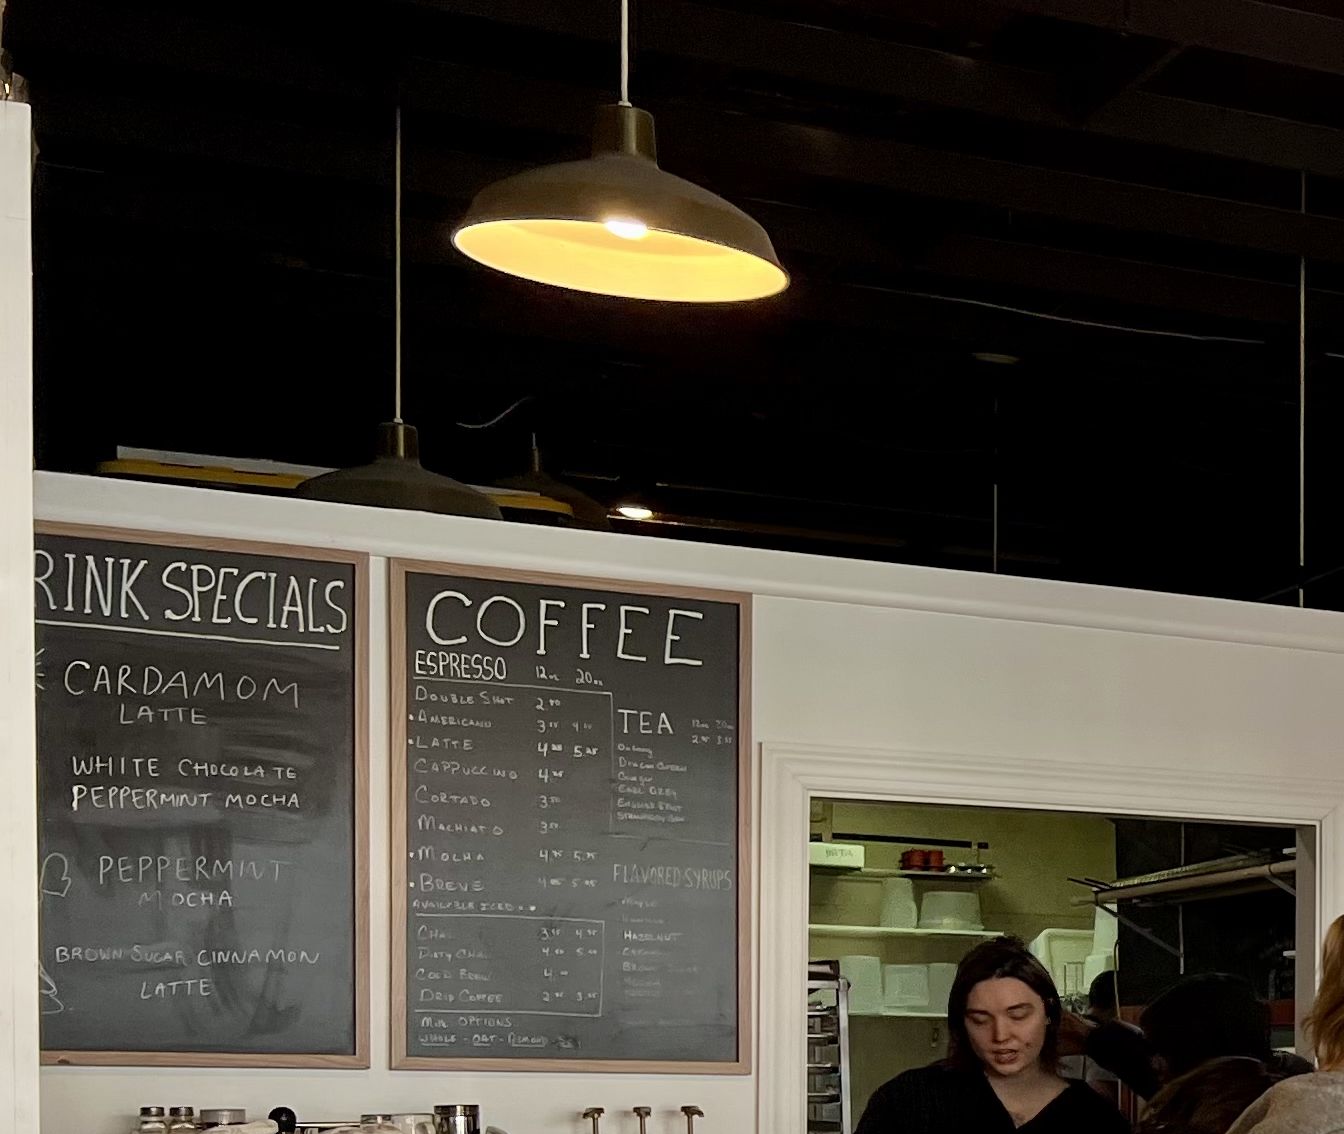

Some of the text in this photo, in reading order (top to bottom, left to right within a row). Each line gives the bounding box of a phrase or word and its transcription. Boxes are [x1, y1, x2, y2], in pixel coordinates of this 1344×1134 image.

[162, 559, 348, 635] SPECIALS
[425, 589, 704, 666] COFFEE
[414, 650, 507, 681] ESPRESSO
[63, 659, 300, 708] CARDAMOM
[415, 685, 475, 705] DOUBLE
[480, 691, 515, 705] SHOT
[119, 705, 207, 726] LATTE
[418, 709, 492, 728] AMERICANO
[618, 708, 674, 735] TEA
[416, 736, 473, 751] LATTE
[72, 755, 297, 780] WHITE CHOCOLATE
[414, 758, 518, 780] CAPPUCCINO
[72, 784, 300, 811] PEPPERMINT MOCHA
[415, 785, 491, 807] CORTADO
[418, 845, 484, 862] MOCHA
[98, 856, 294, 885] PEPPERMINT
[613, 863, 732, 890] FLAVORED SYRUPS
[420, 873, 484, 892] BREVE
[138, 889, 233, 909] MOCHA
[55, 944, 321, 967] BROWN SUGAR CINNAMON
[416, 968, 451, 981] COLD
[140, 978, 212, 1000] LATTE
[420, 989, 454, 1002] DRIP
[459, 989, 503, 1003] COFFEE
